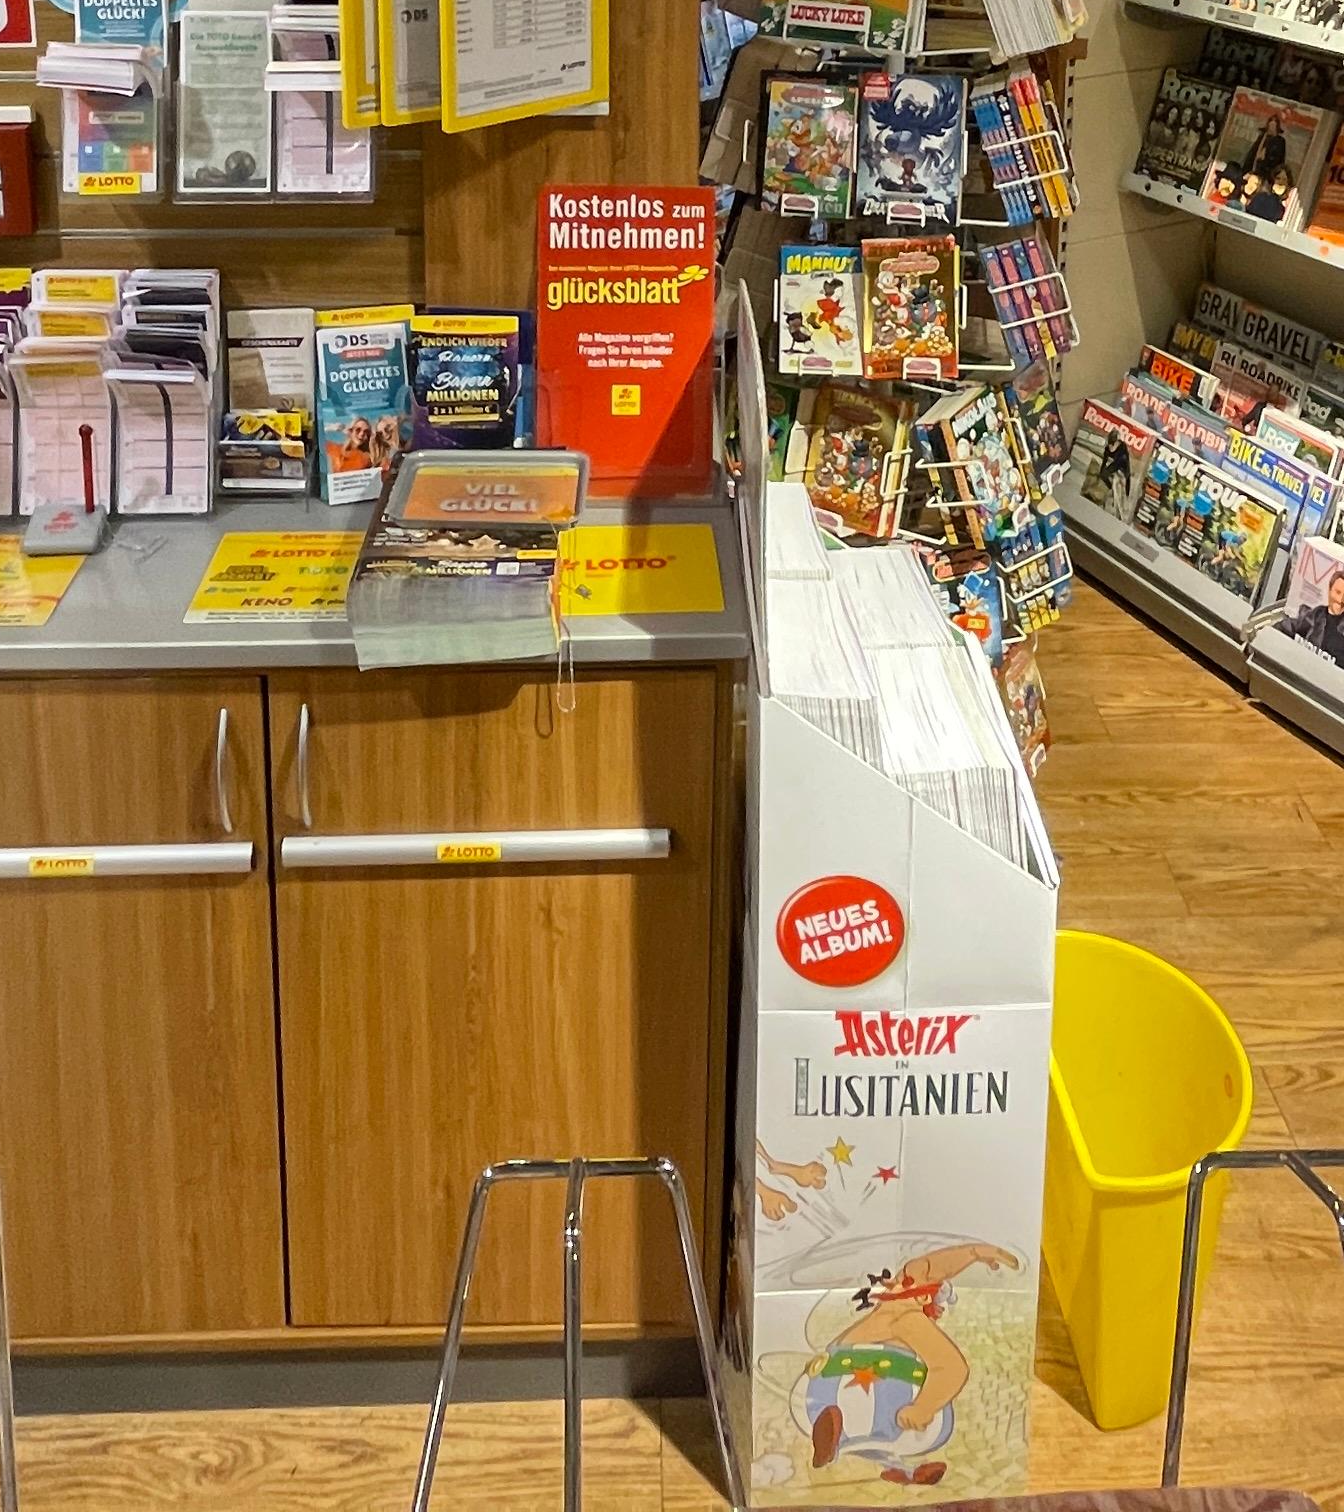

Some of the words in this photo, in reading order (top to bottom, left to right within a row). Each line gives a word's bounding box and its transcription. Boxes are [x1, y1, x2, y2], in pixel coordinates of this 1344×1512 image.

[96, 6, 145, 19] GLÜCK!
[790, 4, 830, 24] LUCKY
[830, 7, 865, 26] LUKE
[98, 175, 134, 186] LOTTO
[549, 194, 663, 218] Kostenlos
[672, 205, 705, 218] zum
[549, 223, 705, 250] Mitnehmen!
[547, 277, 680, 310] glücksblatt
[350, 334, 369, 347] DS
[1243, 313, 1311, 364] GRAVEL
[607, 345, 620, 355] Sie
[330, 366, 401, 383] DOPPELTES
[1151, 358, 1195, 396] BIKE
[1240, 358, 1301, 401] ROADBIKE
[343, 378, 390, 393] GLÜCK!
[426, 389, 499, 402] MILLIONEN
[1228, 435, 1261, 473] BIKE
[464, 484, 520, 495] VIEL
[440, 498, 539, 513] GLÜCK!
[273, 549, 326, 557] LOTTO
[585, 558, 668, 571] LOTTO
[241, 597, 293, 606] KENO
[456, 846, 494, 858] LOTTO
[48, 860, 88, 872] LOTTO
[794, 899, 882, 941] NEUES
[798, 920, 892, 964] ALBUM!
[833, 1011, 975, 1058] Asterix
[792, 1058, 1010, 1118] LUSITANIEN
